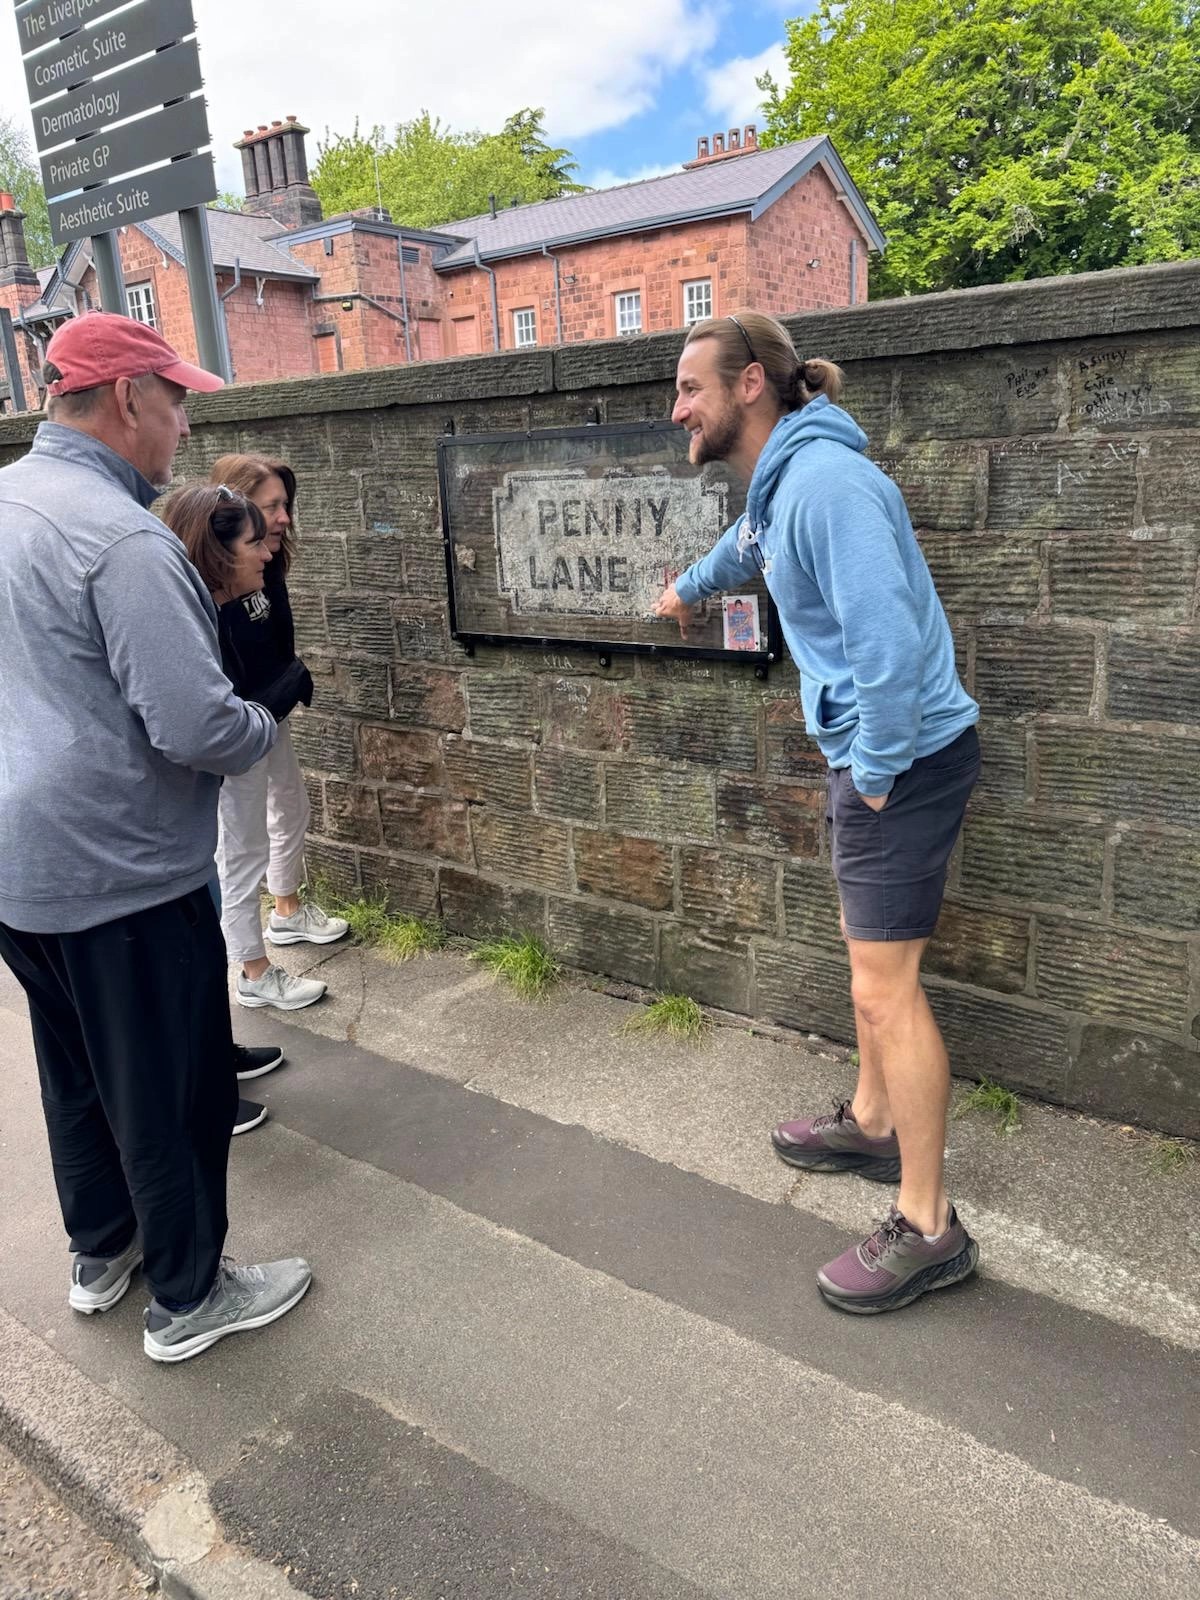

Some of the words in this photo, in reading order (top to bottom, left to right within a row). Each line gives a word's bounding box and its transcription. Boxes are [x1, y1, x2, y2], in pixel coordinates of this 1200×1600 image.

[23, 14, 46, 38] The
[48, 0, 100, 26] Liverpo
[34, 45, 90, 86] Cosmetic
[92, 31, 127, 60] Suite
[41, 90, 120, 136] Dermatology
[50, 157, 91, 185] Private
[92, 145, 111, 167] GP
[59, 198, 115, 231] Aesthetic
[116, 188, 150, 215] Suite
[537, 497, 670, 537] PENNY
[529, 555, 630, 593] LANE
